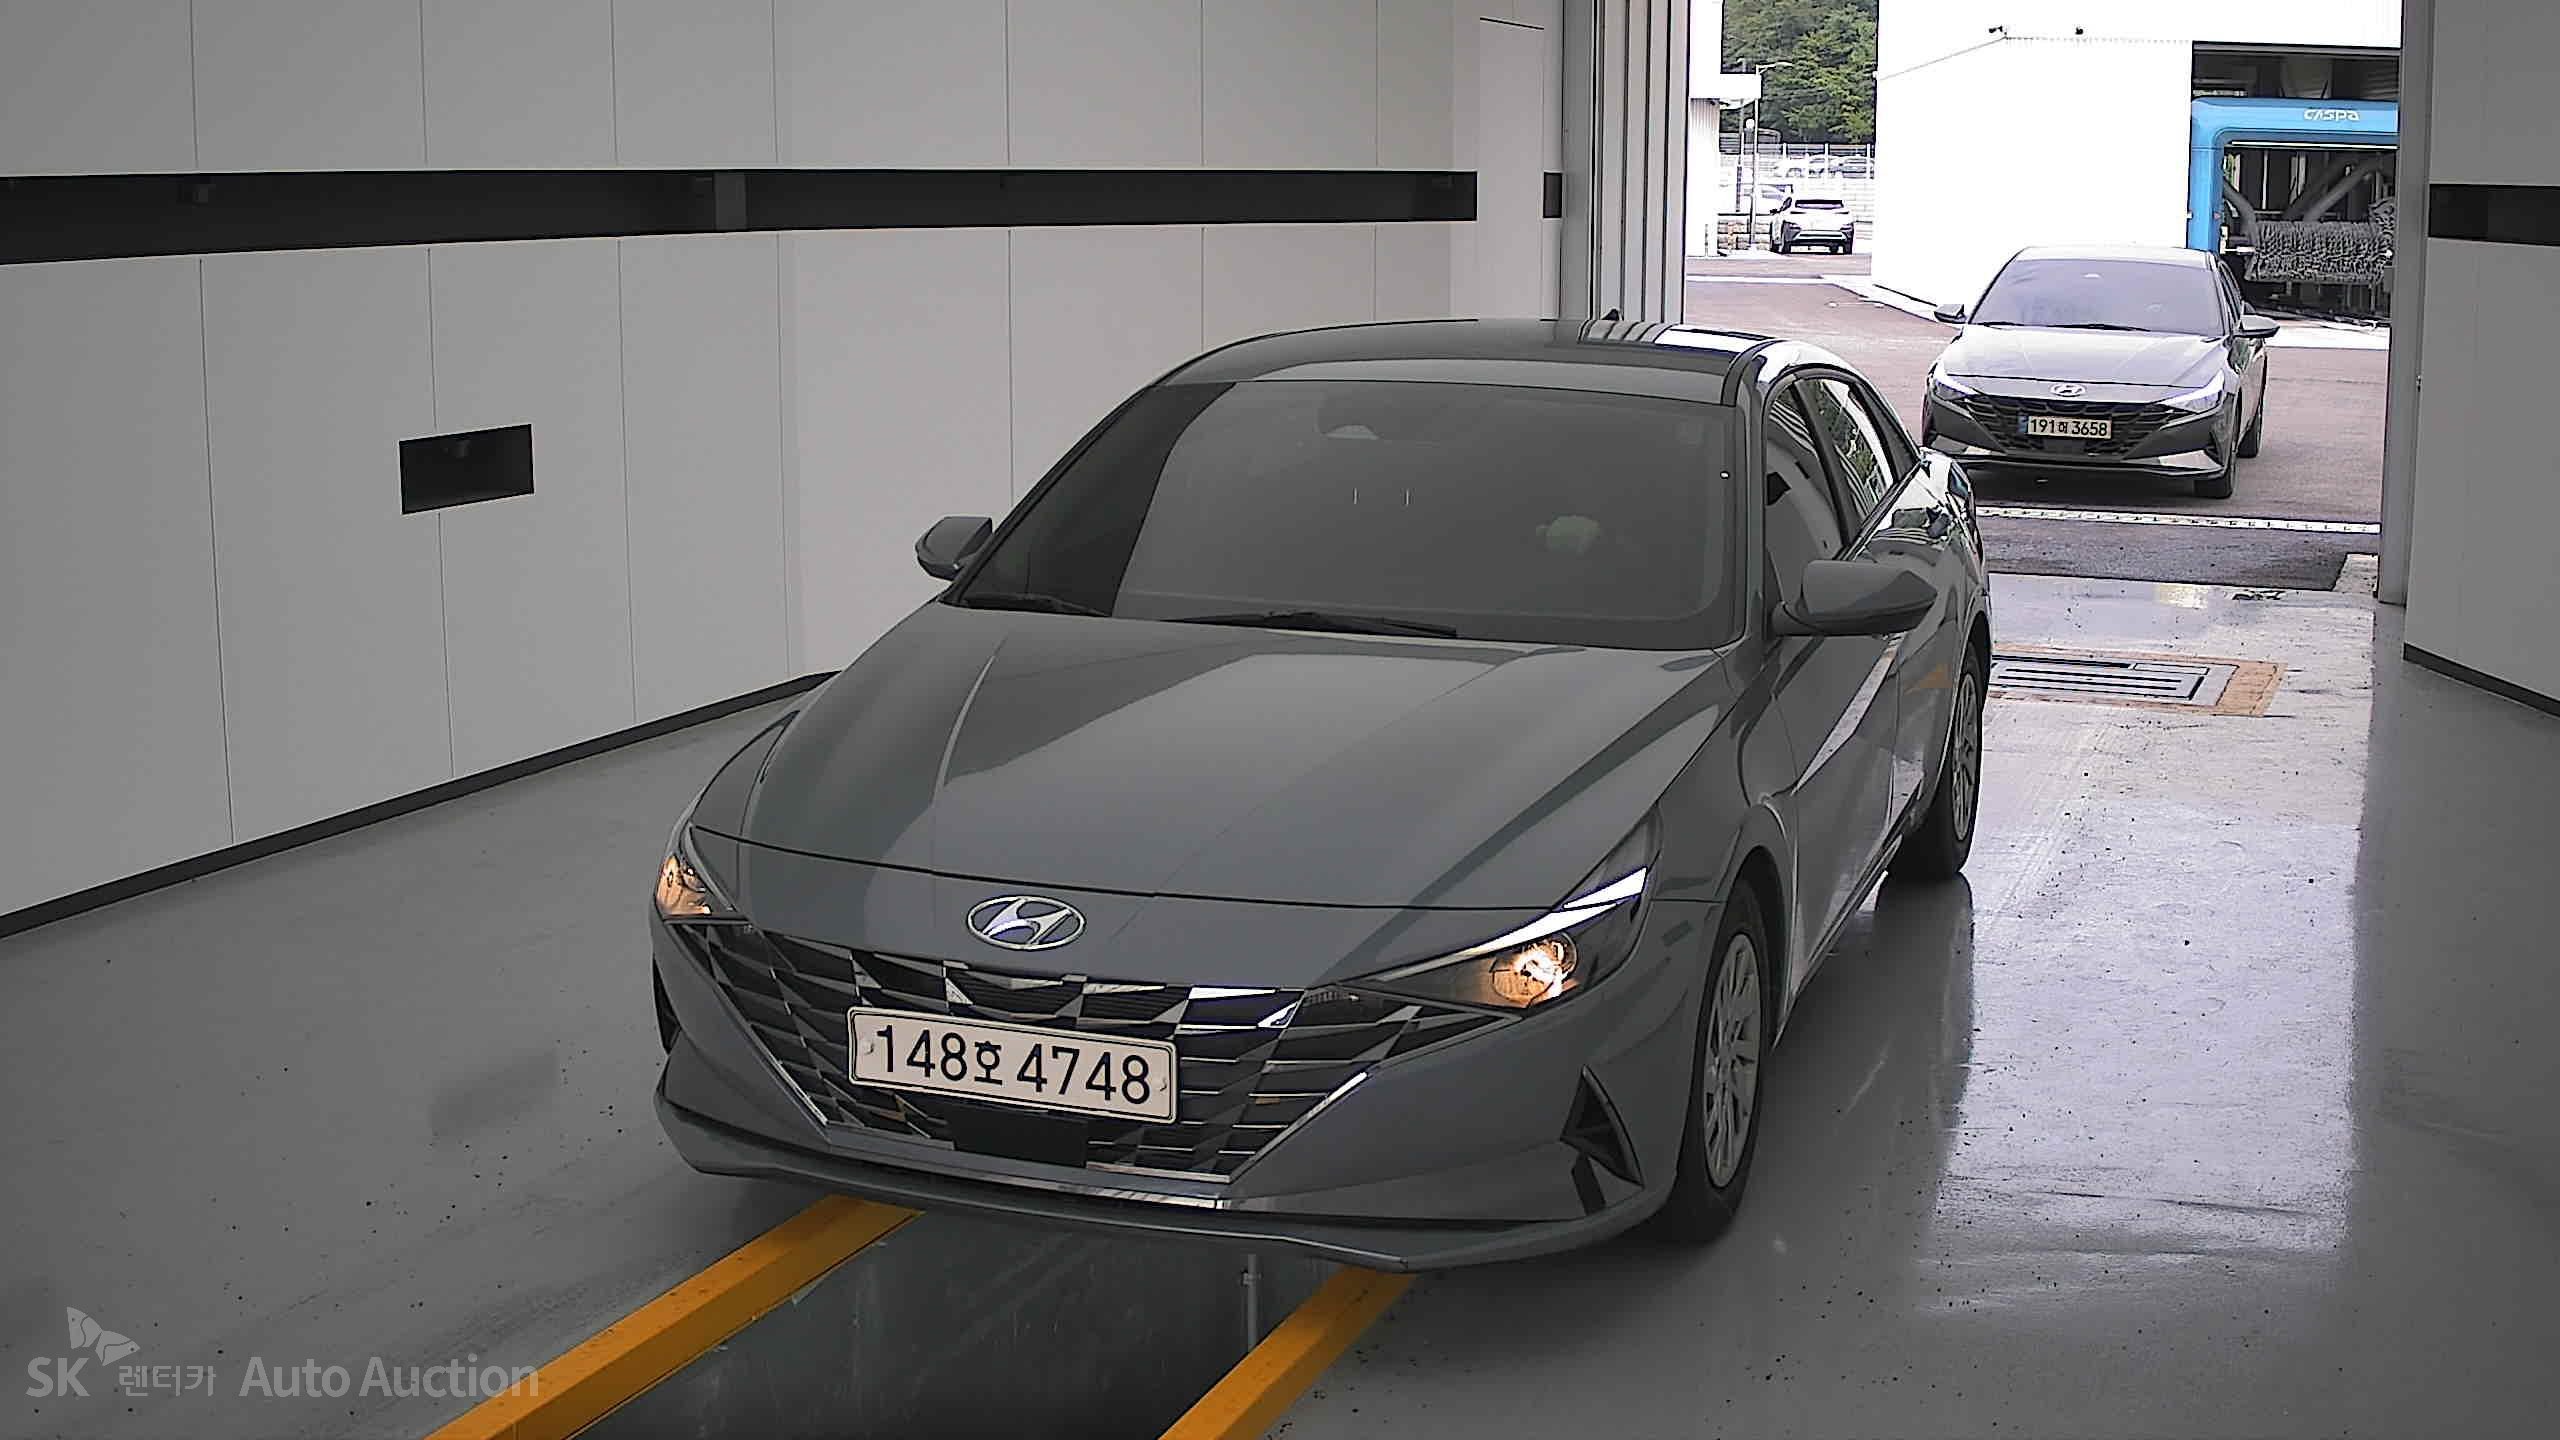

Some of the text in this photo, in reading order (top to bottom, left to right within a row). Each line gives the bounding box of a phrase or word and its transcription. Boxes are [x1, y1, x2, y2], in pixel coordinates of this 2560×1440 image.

[2071, 420, 2107, 436] 3658
[876, 1024, 1150, 1105] 148호 4748
